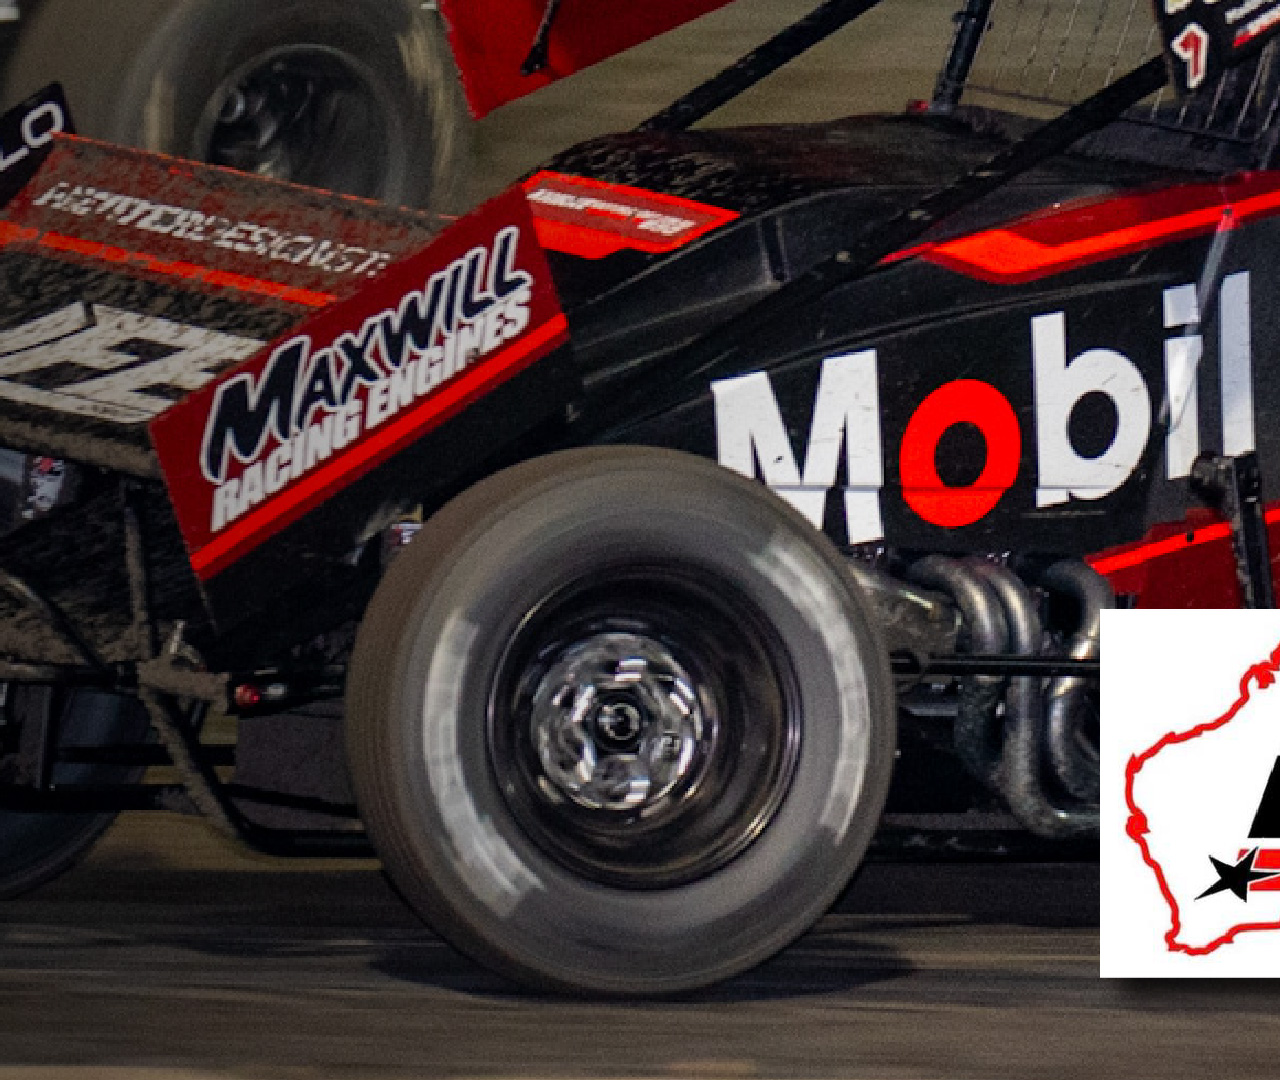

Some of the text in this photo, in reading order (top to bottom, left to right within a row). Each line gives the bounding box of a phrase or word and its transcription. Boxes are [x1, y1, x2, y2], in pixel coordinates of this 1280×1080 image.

[210, 399, 363, 533] RACING
[365, 286, 533, 430] ENGINES
[710, 270, 1257, 545] Mobil
